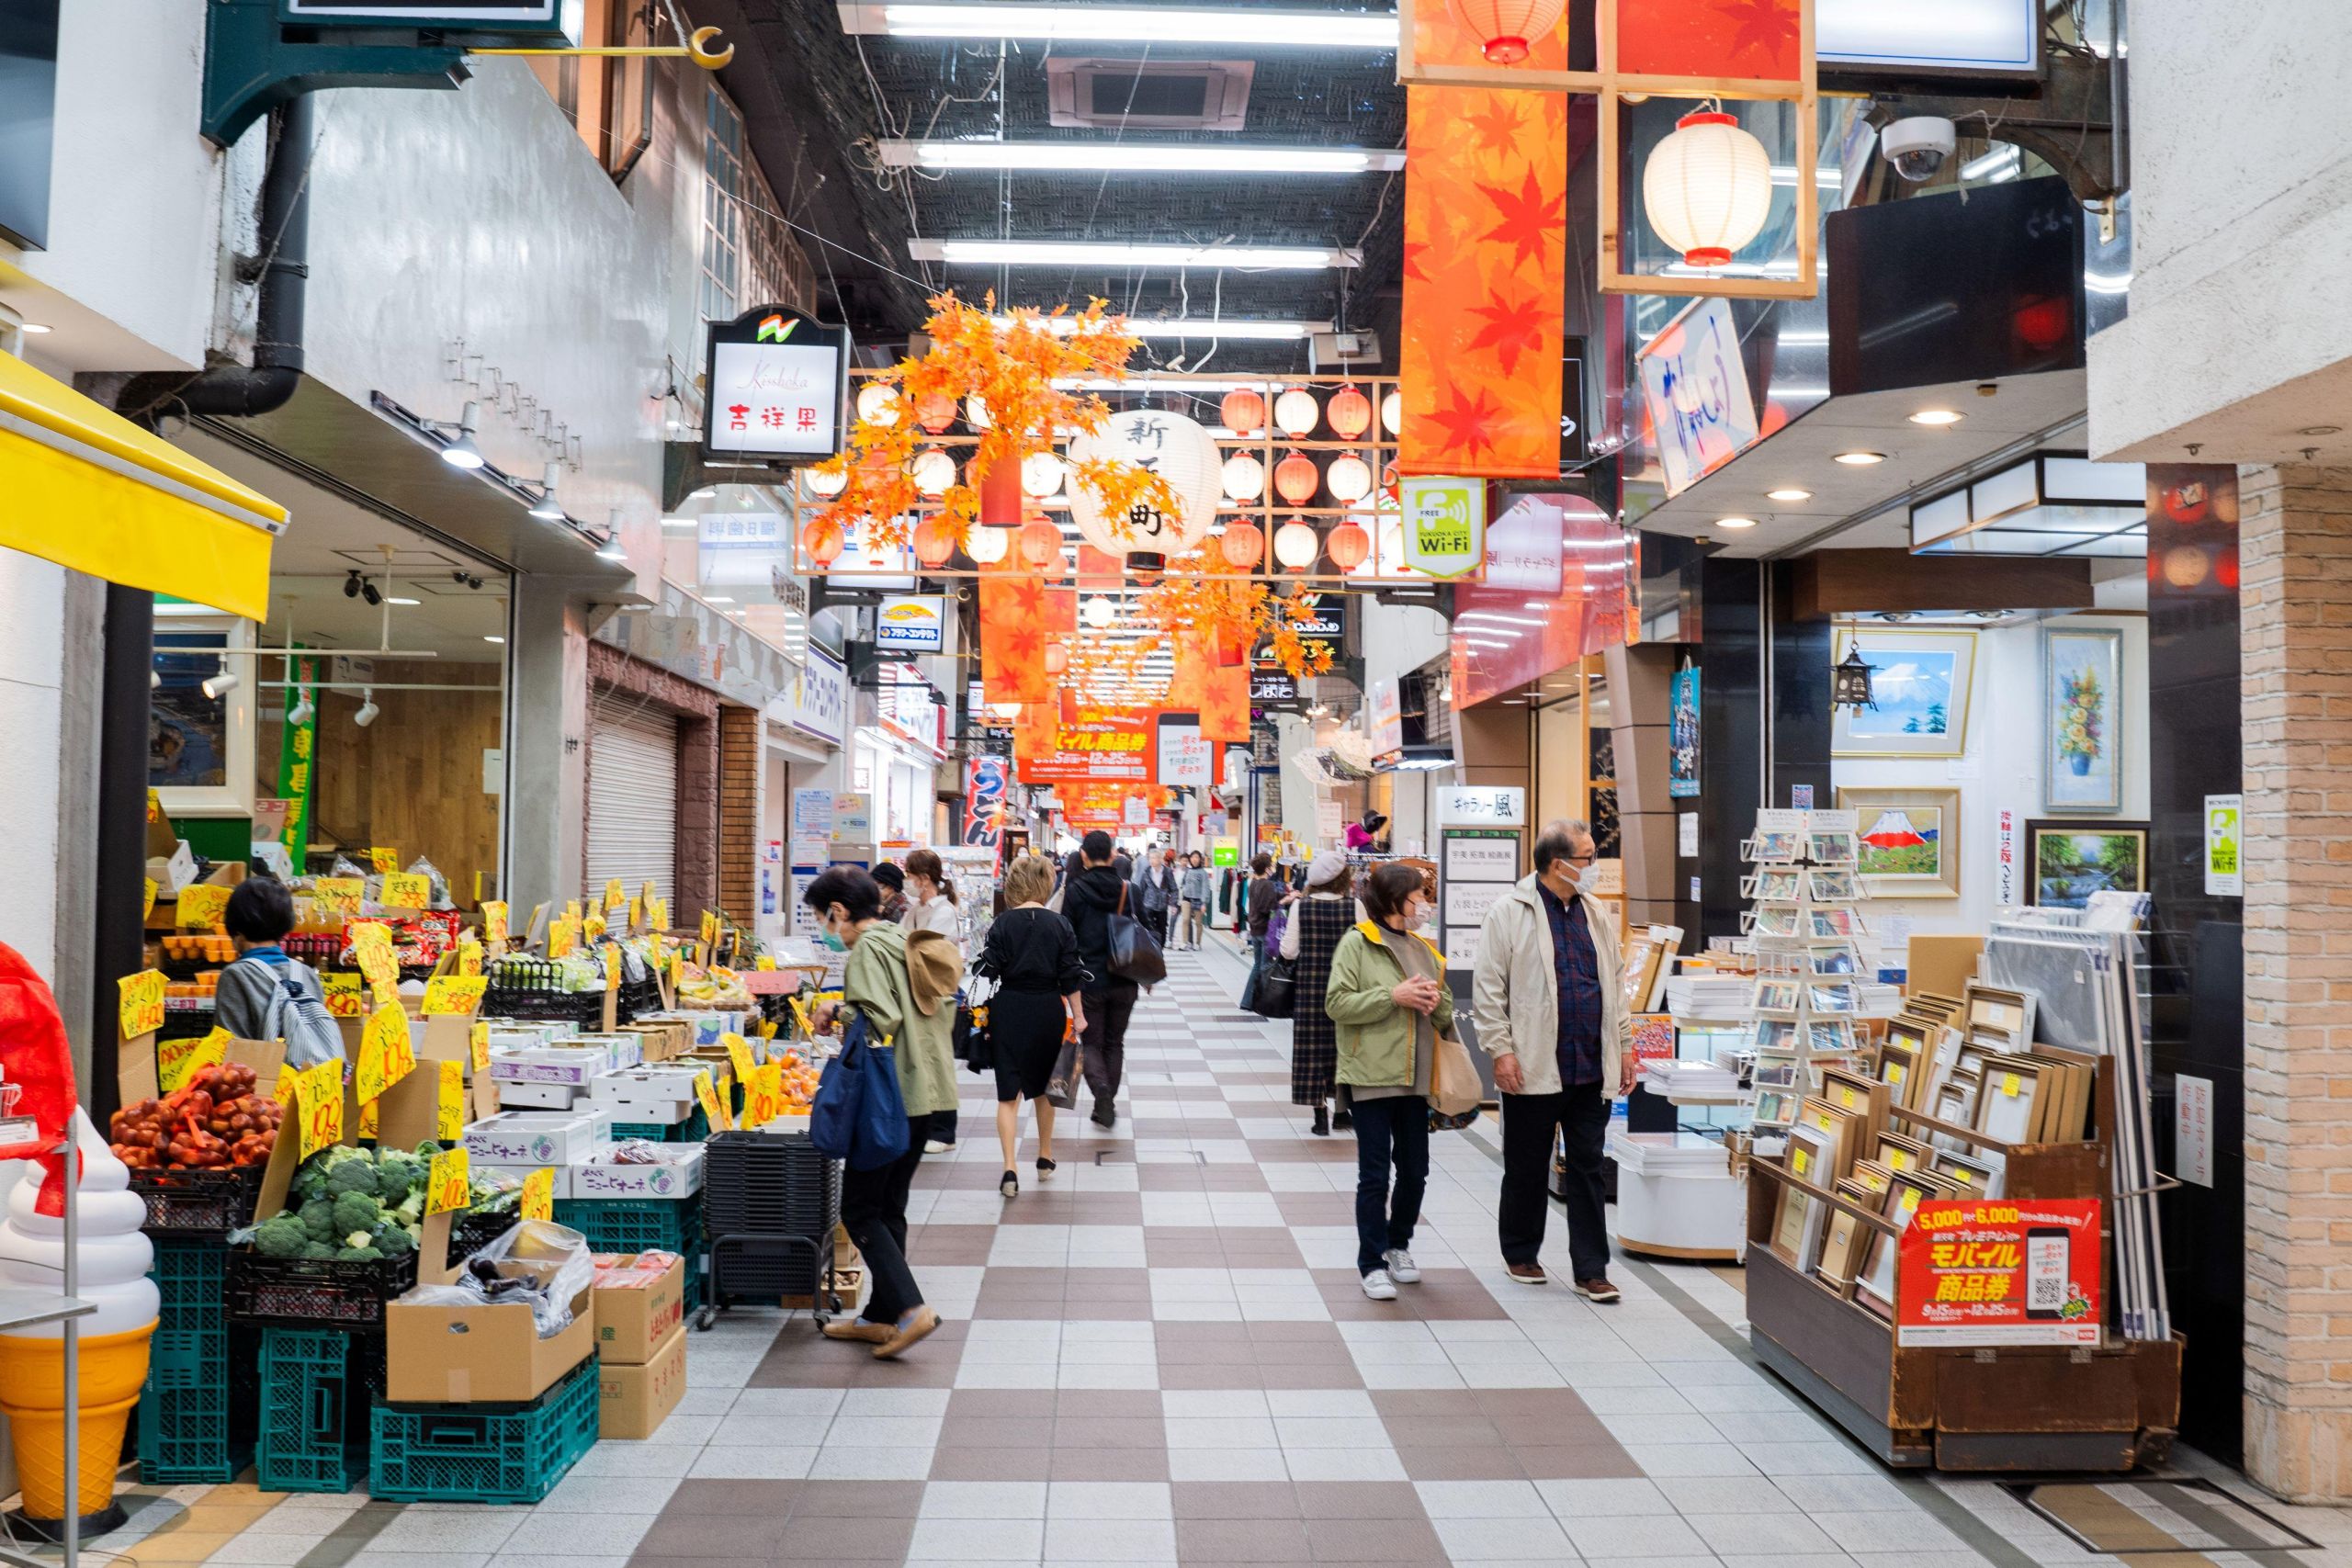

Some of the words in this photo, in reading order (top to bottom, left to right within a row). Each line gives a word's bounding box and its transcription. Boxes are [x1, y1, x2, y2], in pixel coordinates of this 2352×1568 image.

[728, 404, 818, 432] 吉祥果
[1420, 536, 1468, 551] Wi-Fi
[967, 762, 1003, 846] うどん
[1453, 794, 1512, 817] ギャラリー風
[469, 1143, 527, 1159] ニューピオーネ
[587, 1176, 645, 1193] ニューピオーネ
[1930, 1242, 2021, 1268] モバイル
[1935, 1274, 2011, 1302] 商品券
